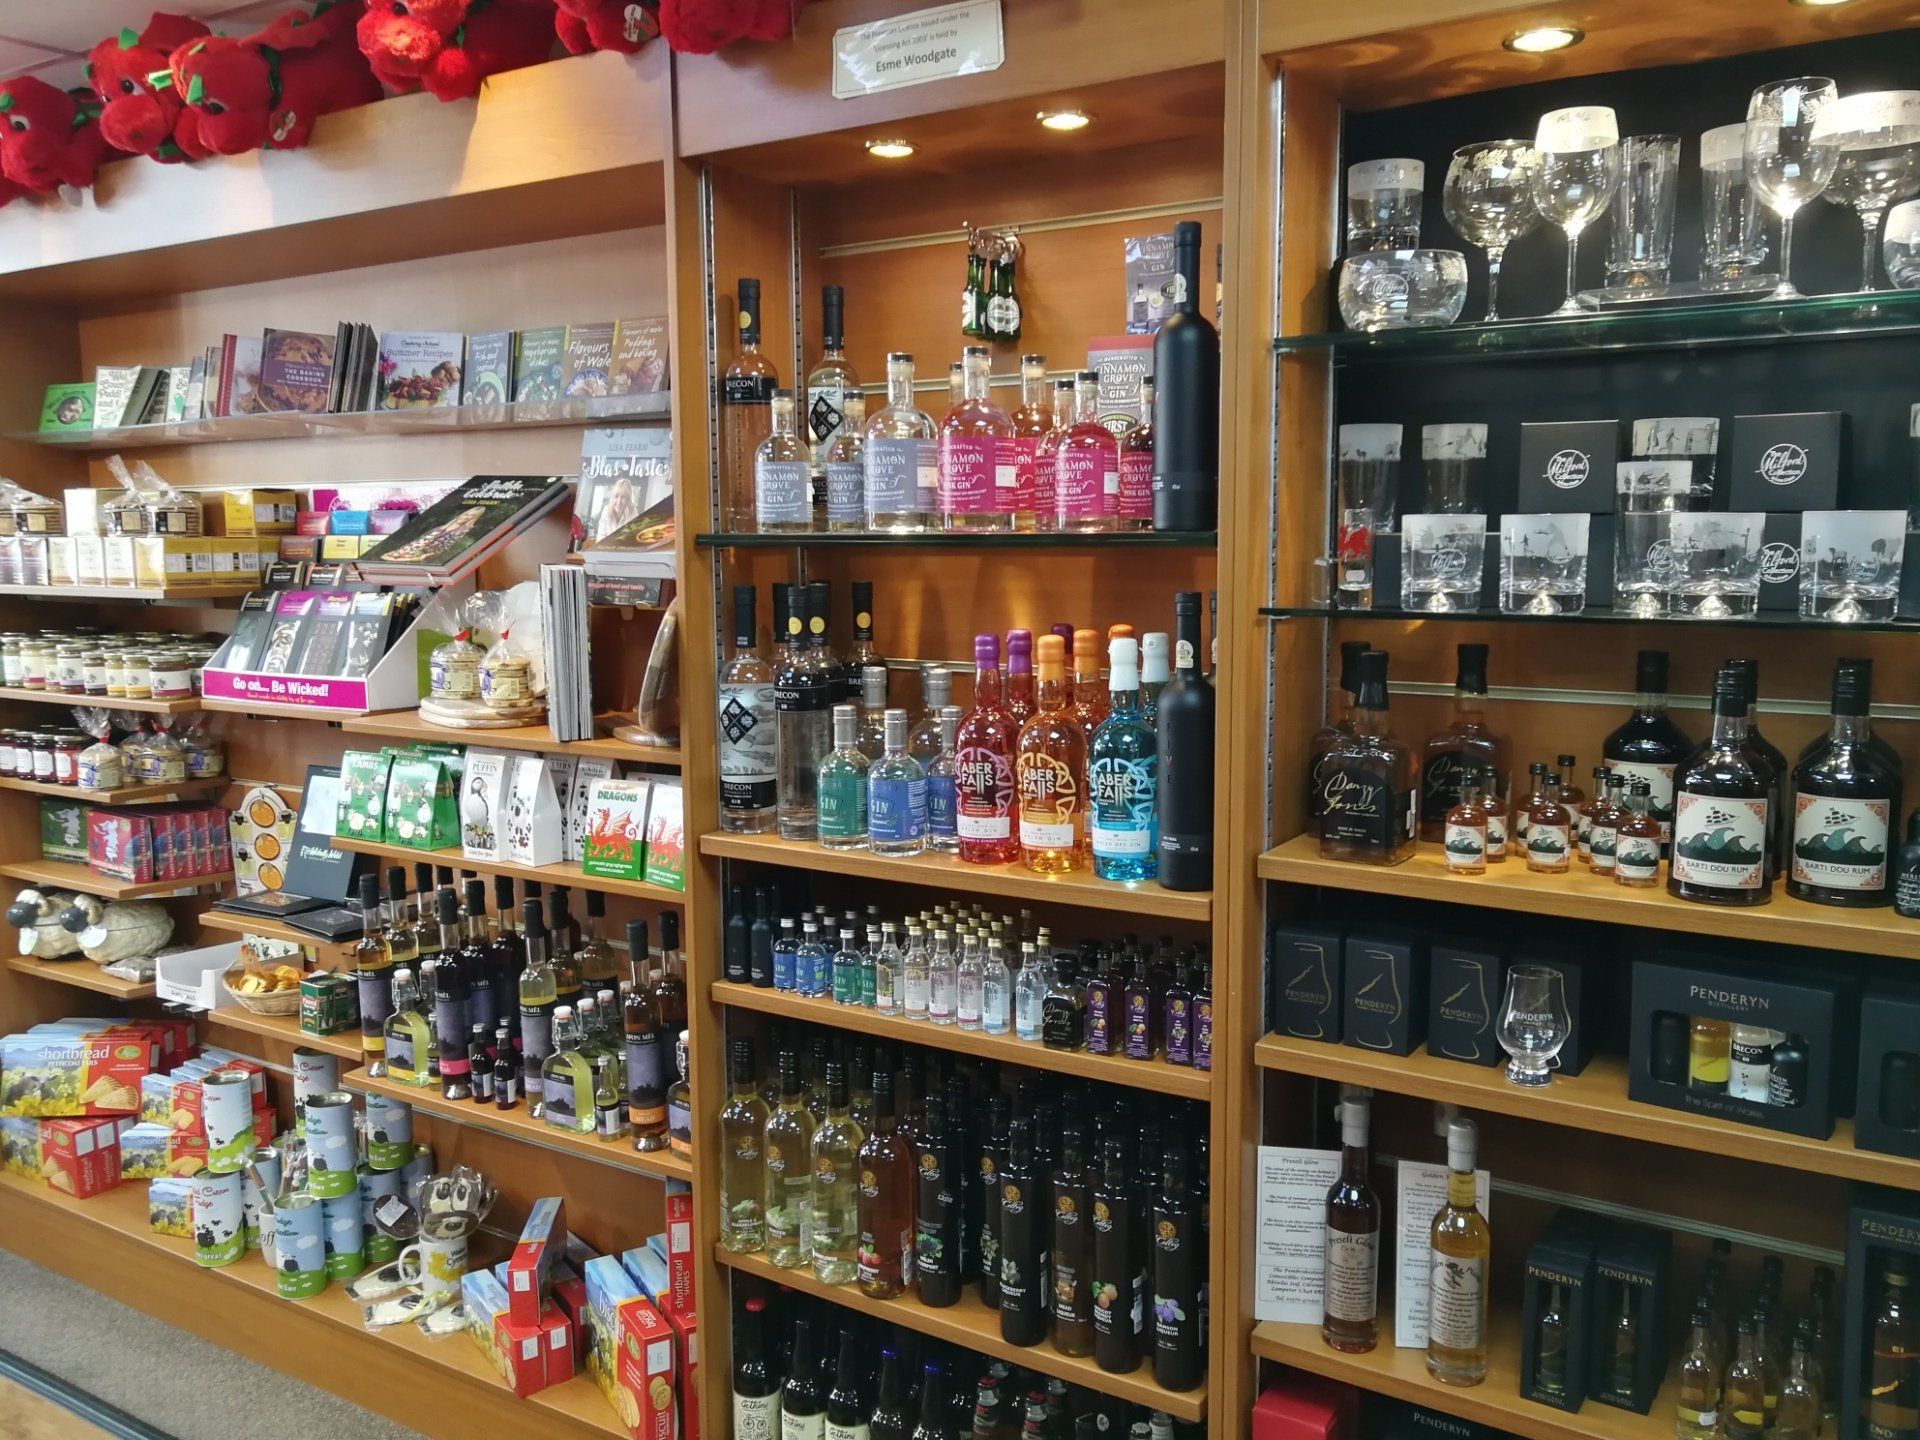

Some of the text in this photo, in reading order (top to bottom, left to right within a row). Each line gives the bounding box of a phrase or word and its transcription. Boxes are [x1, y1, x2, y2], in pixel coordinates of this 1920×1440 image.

[940, 15, 959, 24] under
[959, 12, 970, 20] the
[901, 38, 911, 46] Act
[935, 30, 949, 40] held
[949, 29, 958, 39] by
[876, 47, 957, 73] Esme Woodgate
[423, 349, 454, 359] Recipes
[569, 341, 609, 355] Flavours
[574, 355, 611, 369] of Wale
[1094, 362, 1146, 375] CINNAMON
[1103, 373, 1135, 385] GROVE
[1109, 389, 1127, 399] GIN
[1103, 419, 1128, 435] FIRST
[609, 443, 648, 452] LISA FEARN
[870, 482, 887, 491] GIN
[957, 480, 972, 490] GIN
[1068, 486, 1082, 495] GIN
[1137, 488, 1151, 496] GIN
[767, 495, 784, 504] GIN
[833, 495, 848, 504] GIN
[232, 676, 247, 690] Go
[271, 680, 286, 694] Be
[286, 681, 329, 697] Wicked!
[472, 763, 498, 774] PUFFIN
[962, 762, 993, 775] ABER
[1022, 768, 1055, 782] ABER
[723, 782, 752, 792] BRECON
[1098, 774, 1131, 787] ABER
[597, 790, 638, 804] DRAGONS
[1687, 860, 1709, 871] BARTI
[1731, 865, 1749, 874] RUM
[1805, 861, 1828, 872] BARTI
[1851, 865, 1871, 875] RUM
[1690, 984, 1770, 1010] PENDERYN
[1354, 997, 1396, 1012] PENDERYN
[1440, 1006, 1484, 1022] PENDERYN
[1512, 1010, 1554, 1022] PENDERYN
[37, 1044, 111, 1063] shortbread
[1733, 1043, 1763, 1055] BRECON
[636, 1115, 655, 1123] MEAD
[1861, 1218, 1920, 1243] PENDERY
[1528, 1265, 1583, 1288] PENDERYN
[1598, 1265, 1654, 1288] PENDERYN
[676, 1259, 685, 1310] shortbread
[1413, 1411, 1470, 1438] PENDERYN
